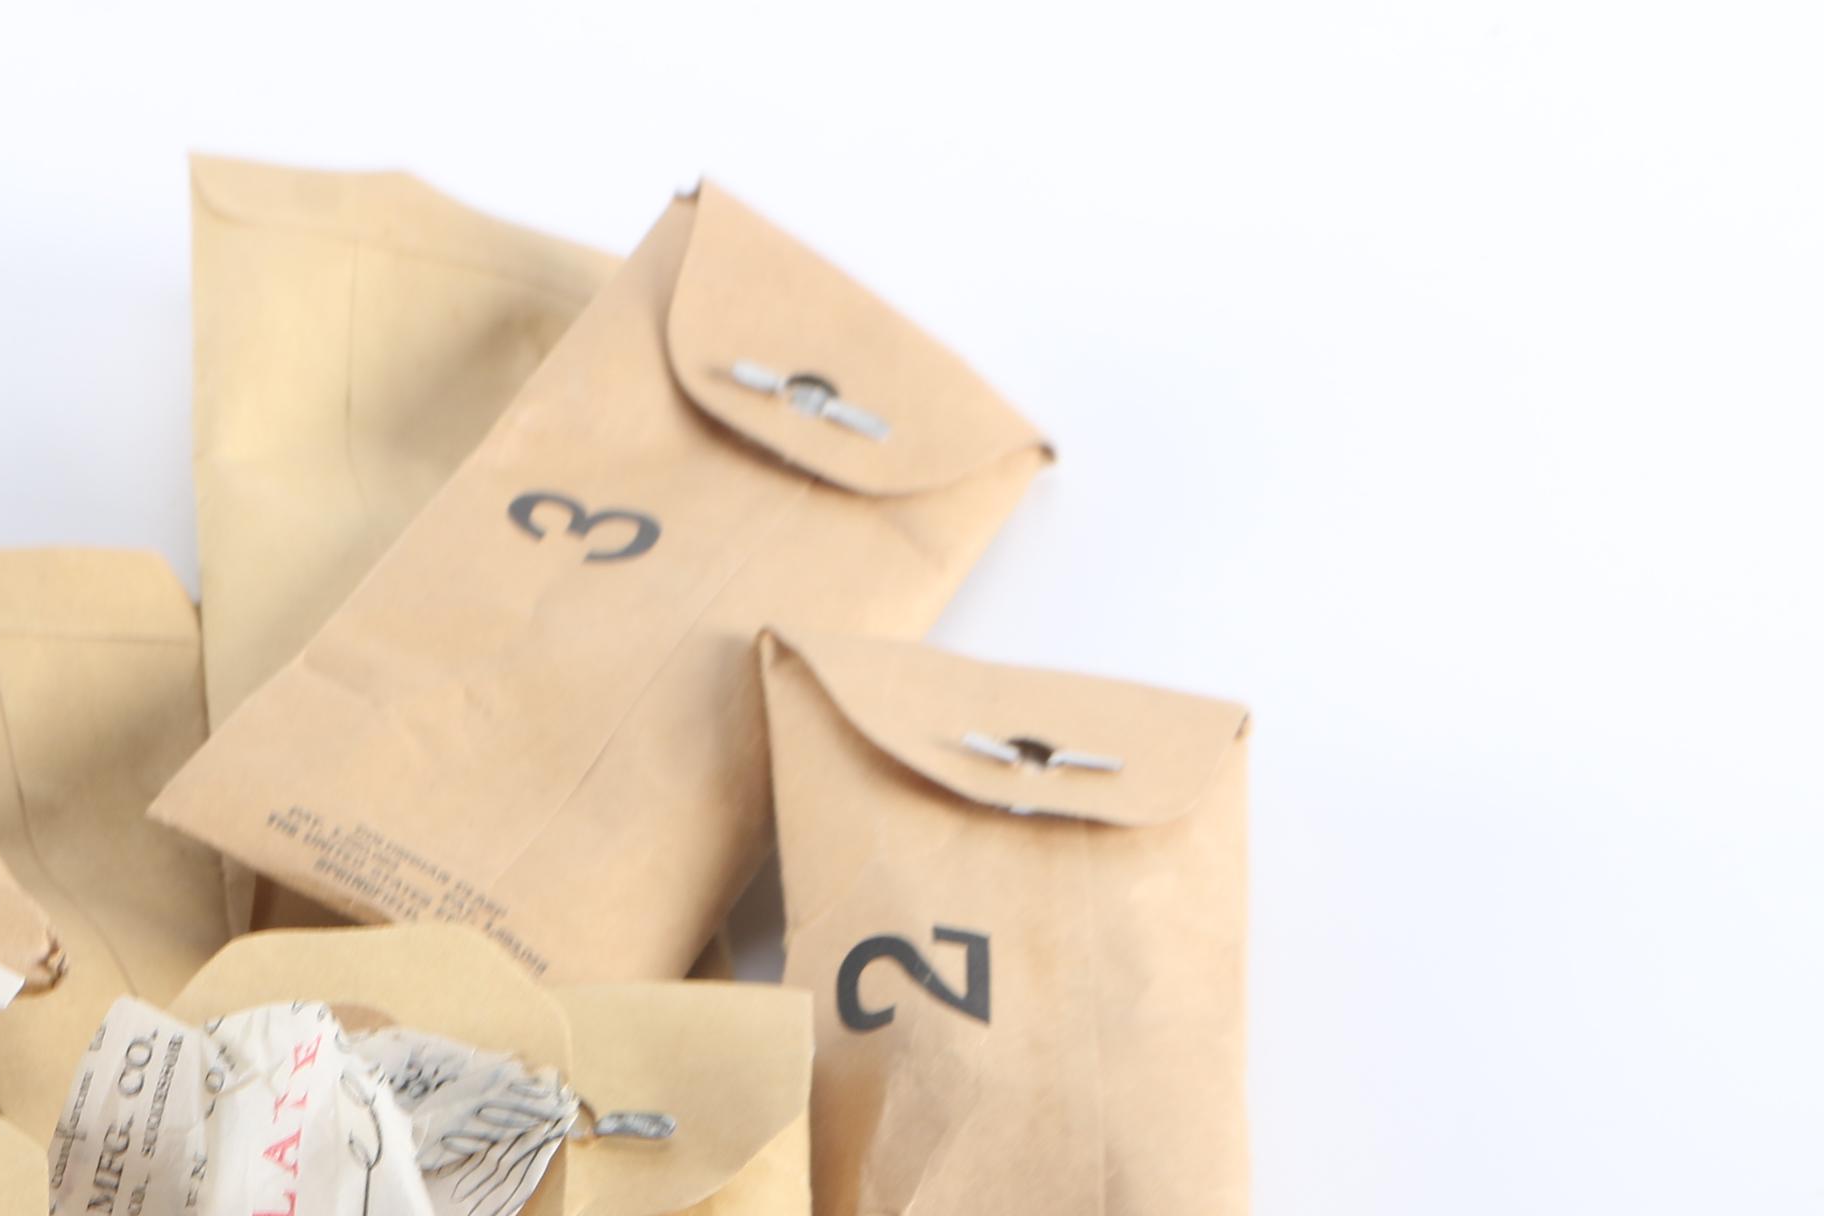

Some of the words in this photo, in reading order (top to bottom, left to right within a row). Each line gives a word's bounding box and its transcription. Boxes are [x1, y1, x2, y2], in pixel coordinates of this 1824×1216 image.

[507, 490, 660, 563] 3
[836, 925, 990, 1031] 2
[118, 1028, 159, 1097] CO.
